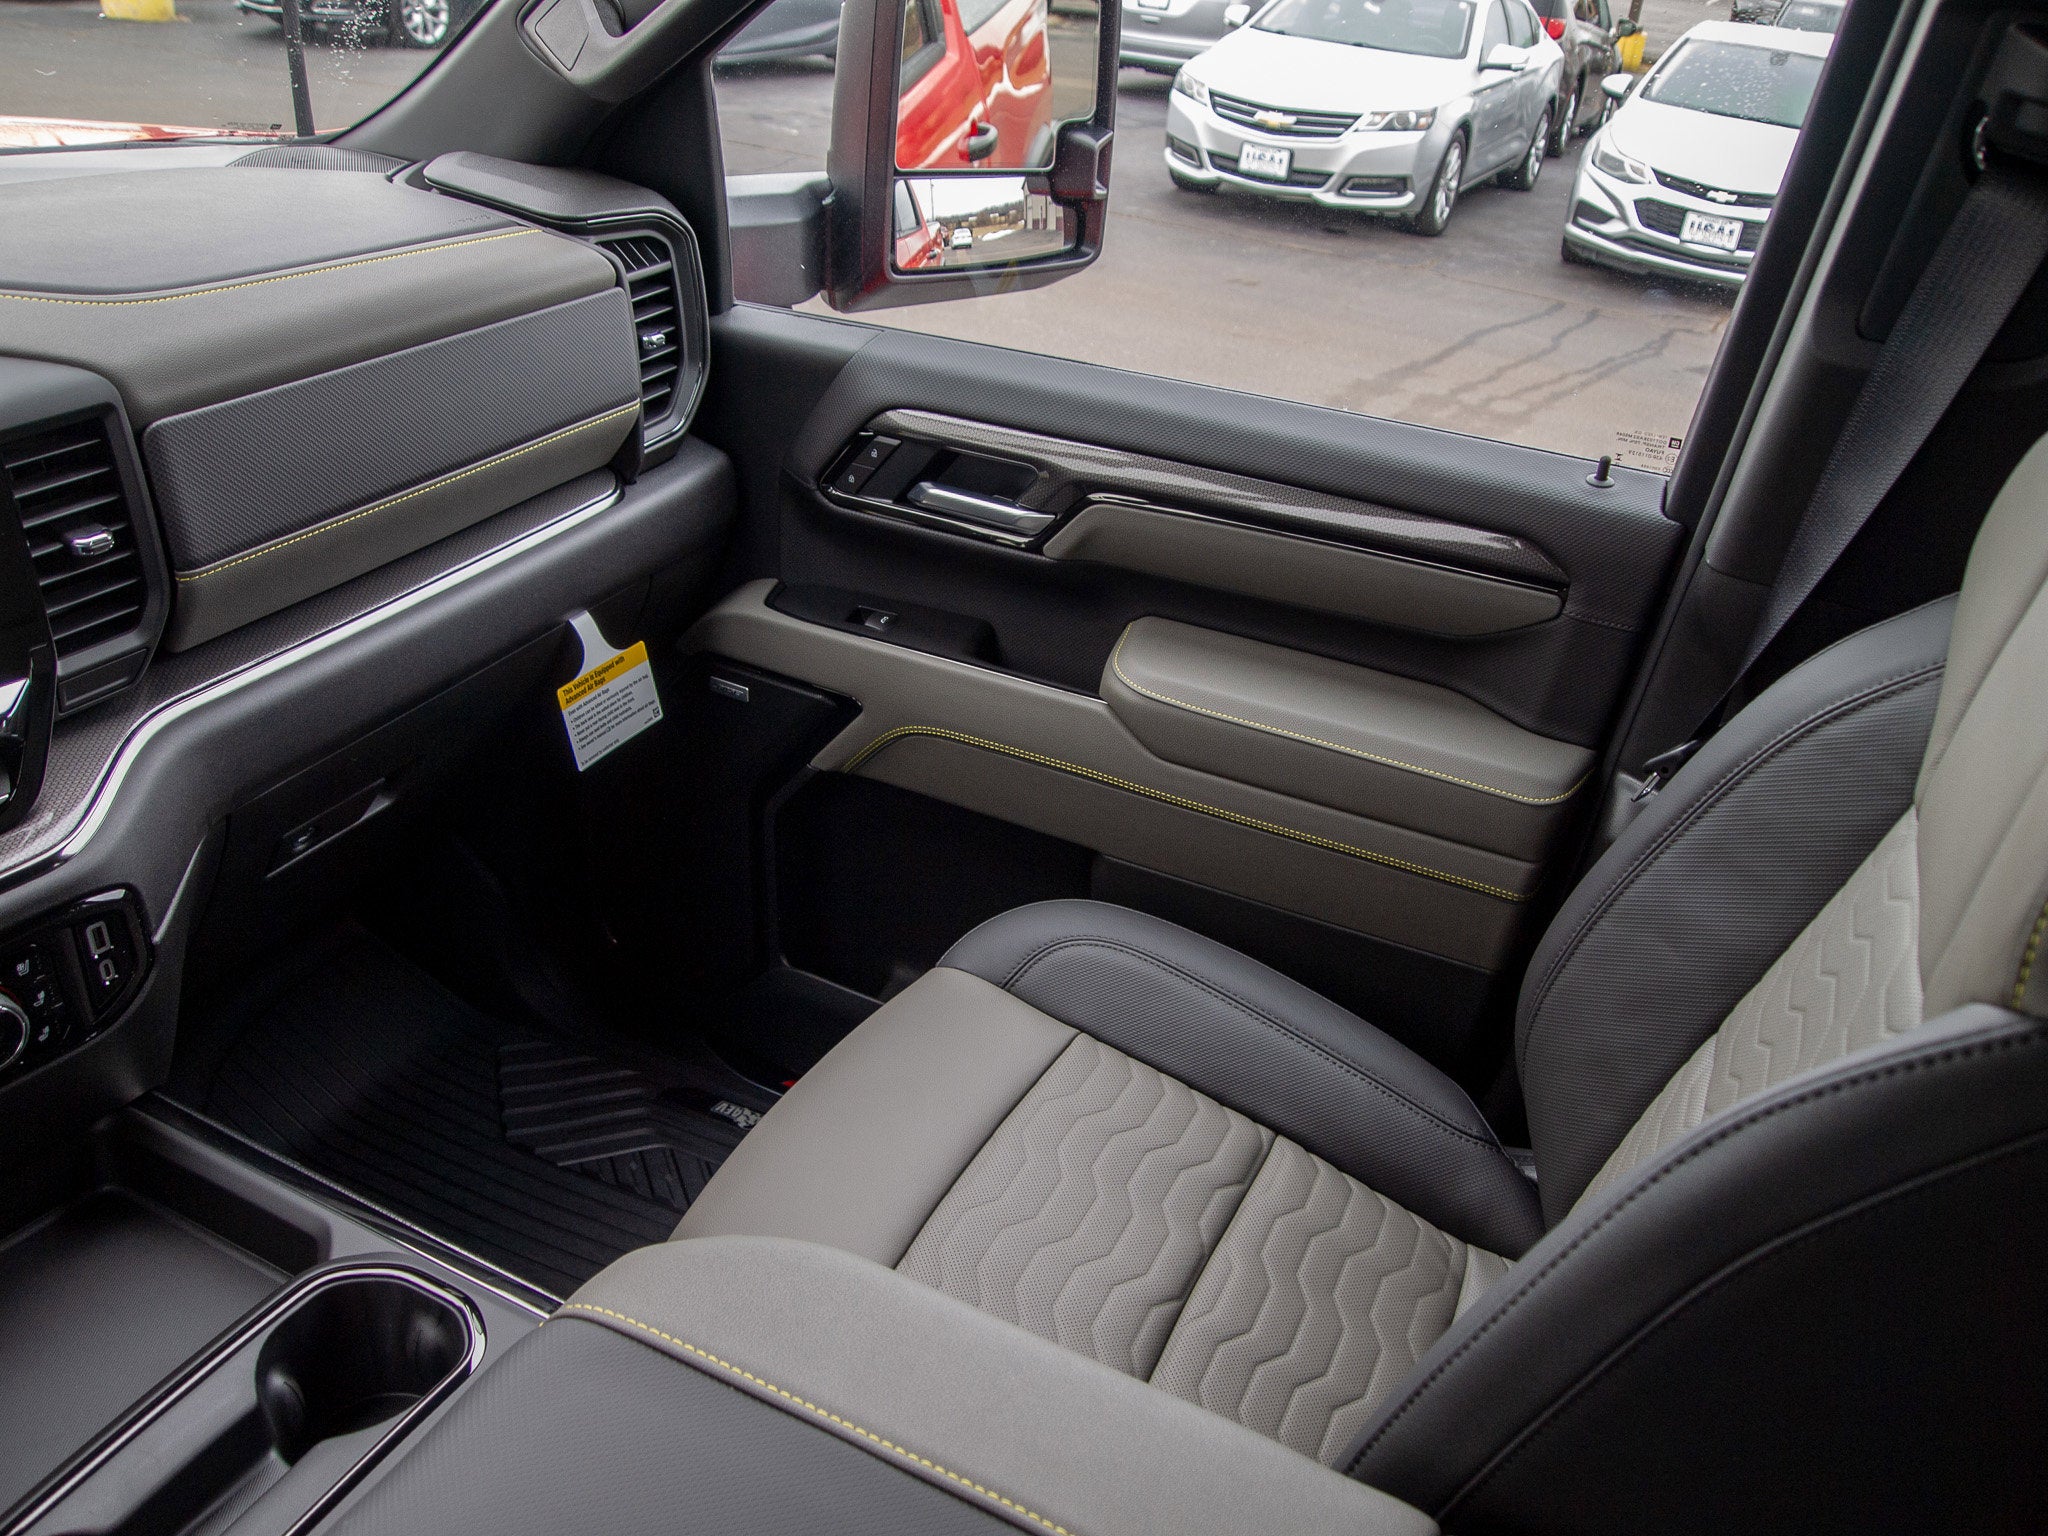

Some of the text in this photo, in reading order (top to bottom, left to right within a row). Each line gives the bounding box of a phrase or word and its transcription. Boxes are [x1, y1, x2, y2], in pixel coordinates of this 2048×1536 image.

[562, 686, 572, 695] This
[573, 677, 589, 689] Vehicle
[594, 662, 614, 677] Equipped
[614, 656, 624, 665] with
[565, 687, 586, 703] Advanced
[594, 676, 606, 688] Bags
